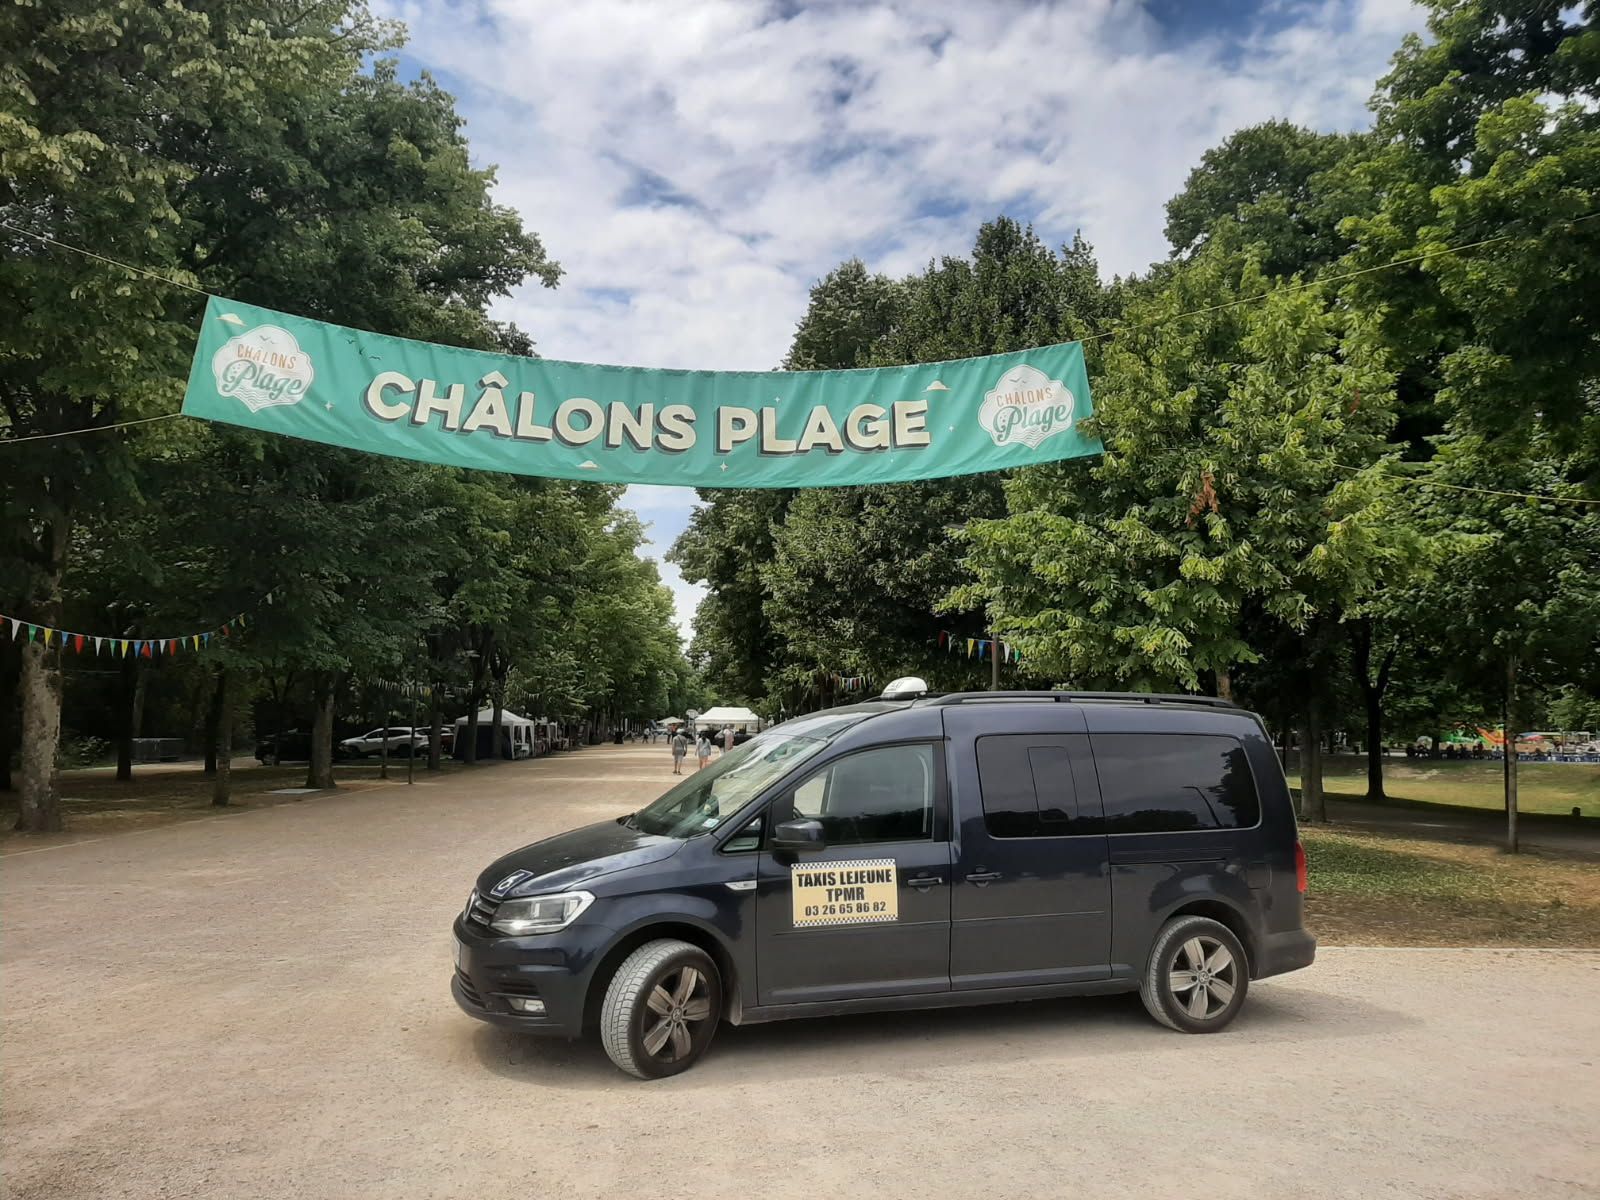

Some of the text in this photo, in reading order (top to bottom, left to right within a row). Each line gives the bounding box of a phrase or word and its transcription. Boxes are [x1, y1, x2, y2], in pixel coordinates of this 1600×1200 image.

[222, 359, 308, 401] Plage
[365, 371, 931, 455] CHÂLONS PLAGE
[993, 404, 1072, 442] Plage
[796, 869, 892, 887] TAXIS LEJEUNE
[826, 887, 865, 902] TPMR
[805, 905, 819, 916] 03
[822, 904, 836, 915] 26
[839, 903, 853, 914] 65
